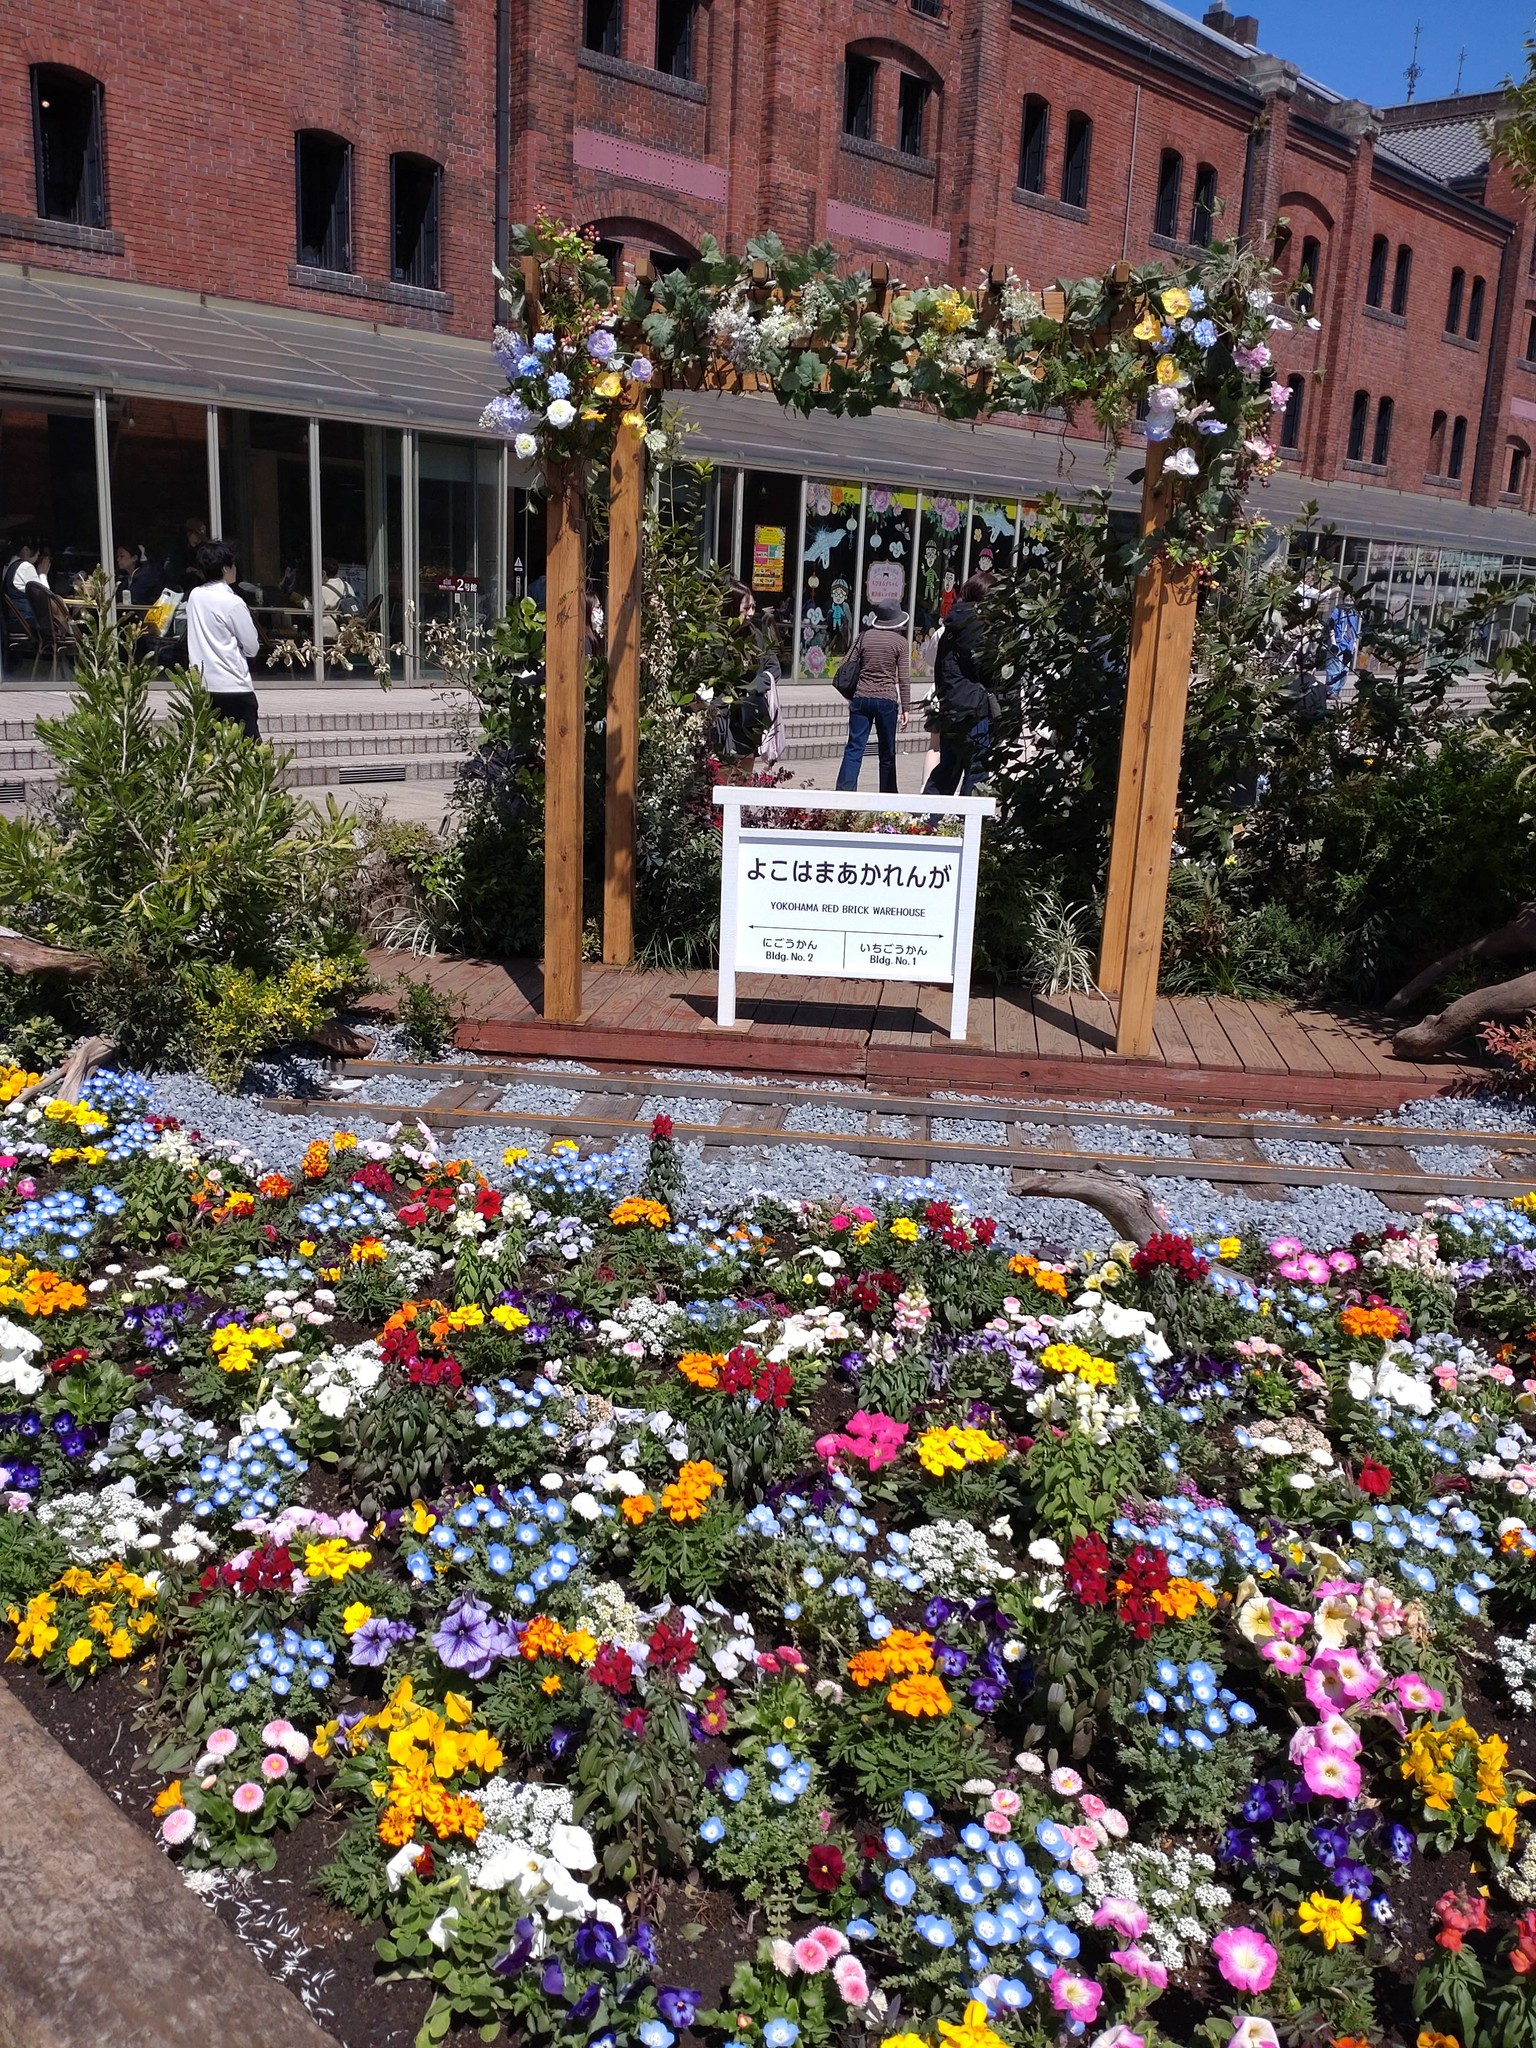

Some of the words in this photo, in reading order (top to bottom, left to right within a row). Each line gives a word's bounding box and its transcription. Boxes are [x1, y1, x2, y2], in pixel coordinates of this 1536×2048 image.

[747, 857, 952, 889] よこはまあかれんが
[770, 901, 819, 912] YOKOHAMA
[821, 903, 839, 913] RED
[842, 904, 869, 915] BRICK
[873, 906, 926, 917] WAREHOUSE
[762, 937, 818, 950] にごうかん
[860, 943, 928, 956] いちごうかん
[765, 951, 789, 962] Bldg.
[791, 952, 806, 961] No.
[807, 953, 814, 962] 2
[869, 955, 894, 966] Bldg.
[895, 956, 911, 966] No.
[912, 957, 917, 966] 1
